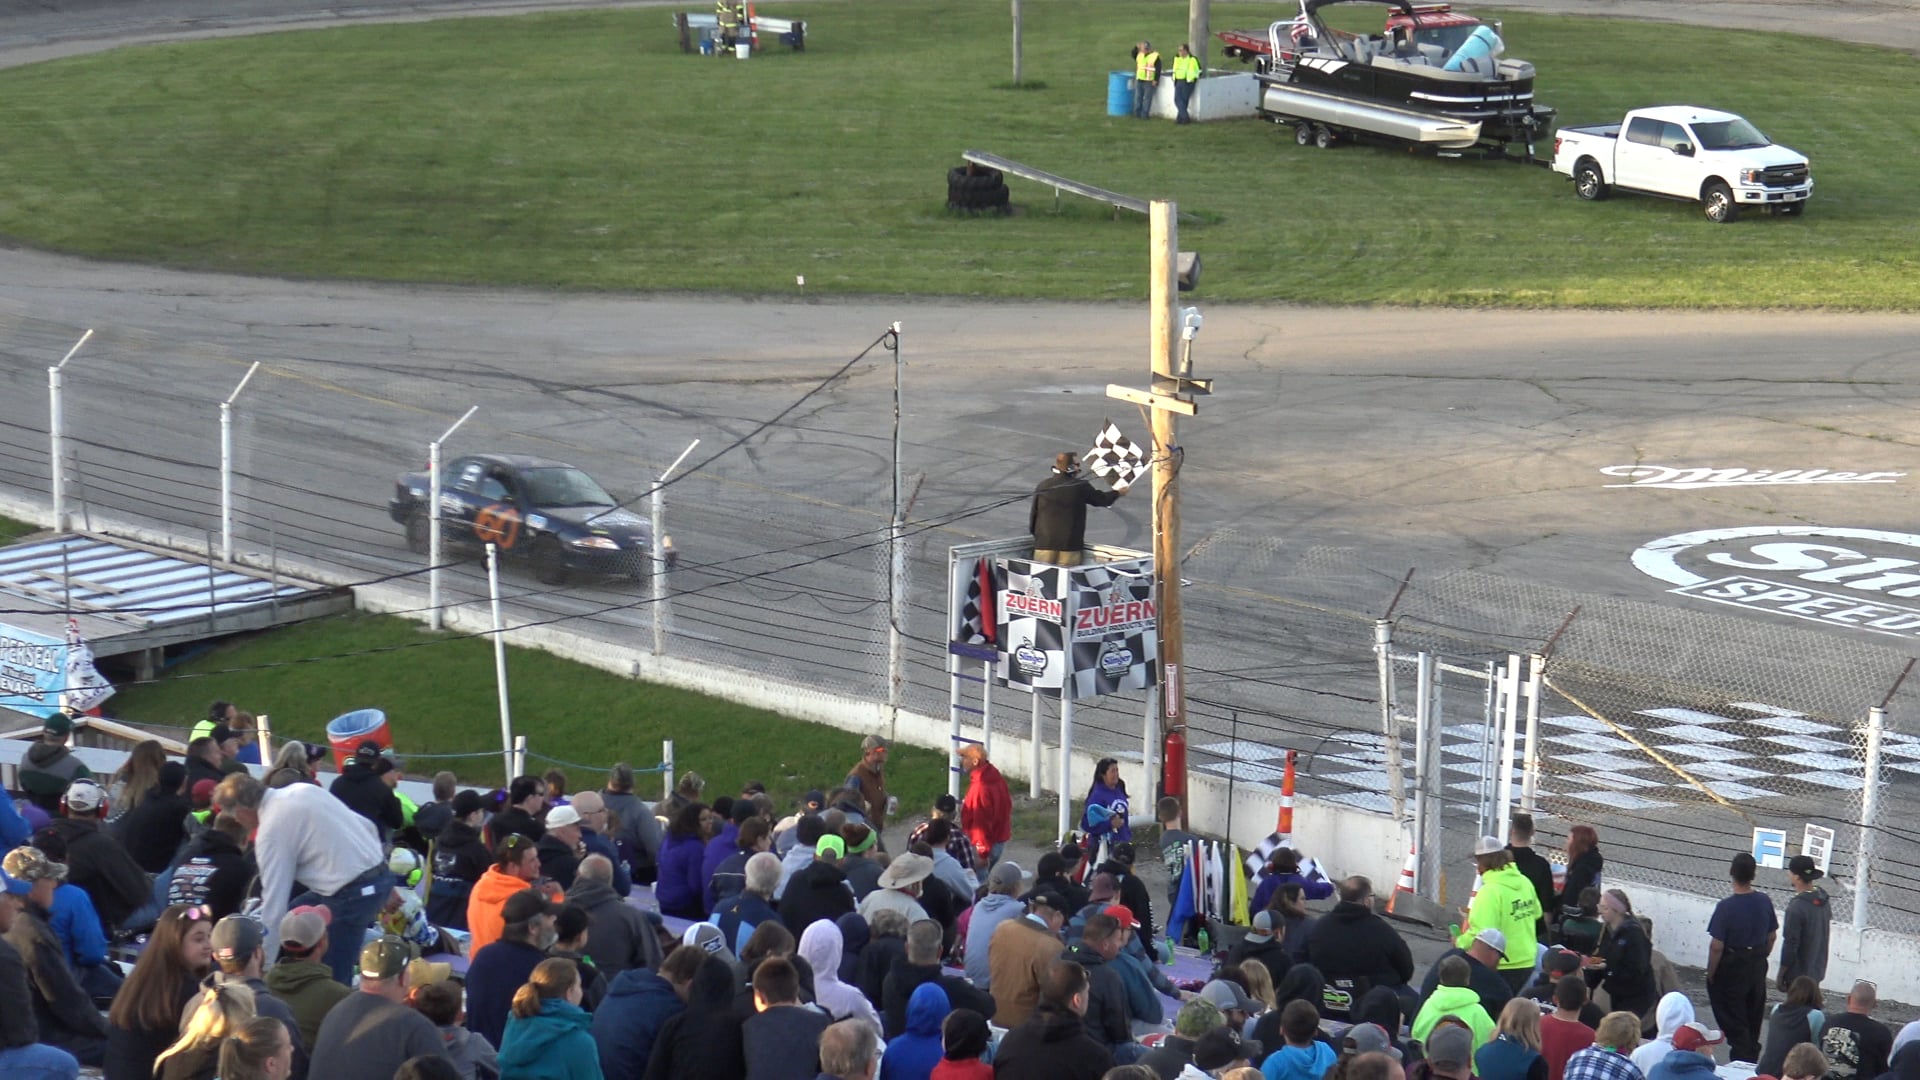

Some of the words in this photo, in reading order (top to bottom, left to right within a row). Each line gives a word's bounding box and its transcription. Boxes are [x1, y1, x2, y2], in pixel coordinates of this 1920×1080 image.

[1600, 465, 1907, 487] Miller
[1006, 593, 1062, 616] ZUERN
[1078, 600, 1157, 629] ZUERN
[1077, 627, 1108, 637] BUILDING
[1019, 650, 1045, 665] Slinger
[1103, 654, 1131, 667] Slinger
[1755, 831, 1783, 864] F
